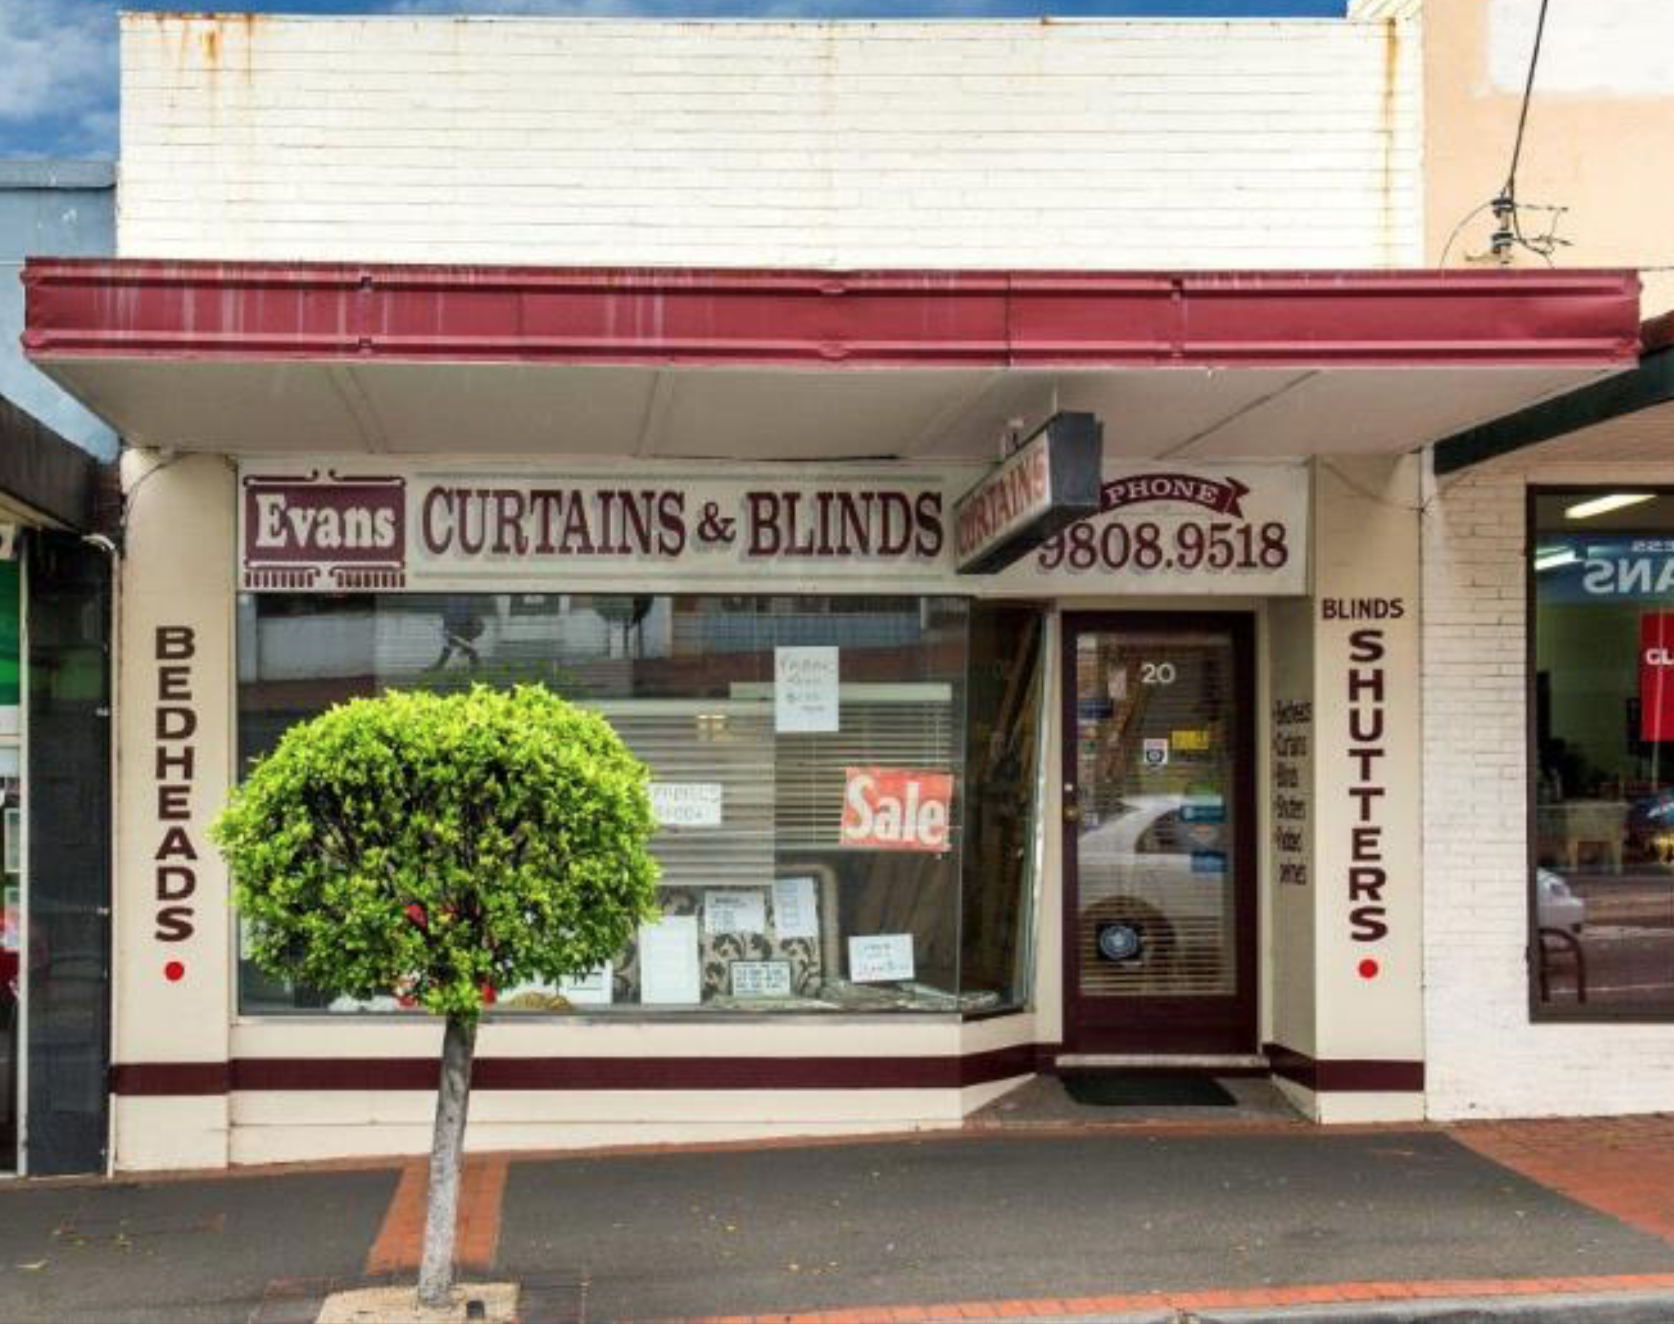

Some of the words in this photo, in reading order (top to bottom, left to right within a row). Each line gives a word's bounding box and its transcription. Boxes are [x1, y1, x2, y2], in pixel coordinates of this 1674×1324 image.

[1105, 479, 1219, 504] PHONE
[255, 494, 396, 548] Evans
[422, 486, 686, 557] CURTAINS
[697, 502, 736, 543] &
[747, 491, 944, 558] BLINDS
[1039, 522, 1289, 569] 9808.9518
[1322, 598, 1404, 620] BLINDS
[1141, 663, 1176, 684] 20
[155, 626, 198, 942] BEDHEADS
[844, 773, 946, 845] Sale
[1347, 629, 1388, 943] SHUTTERS
